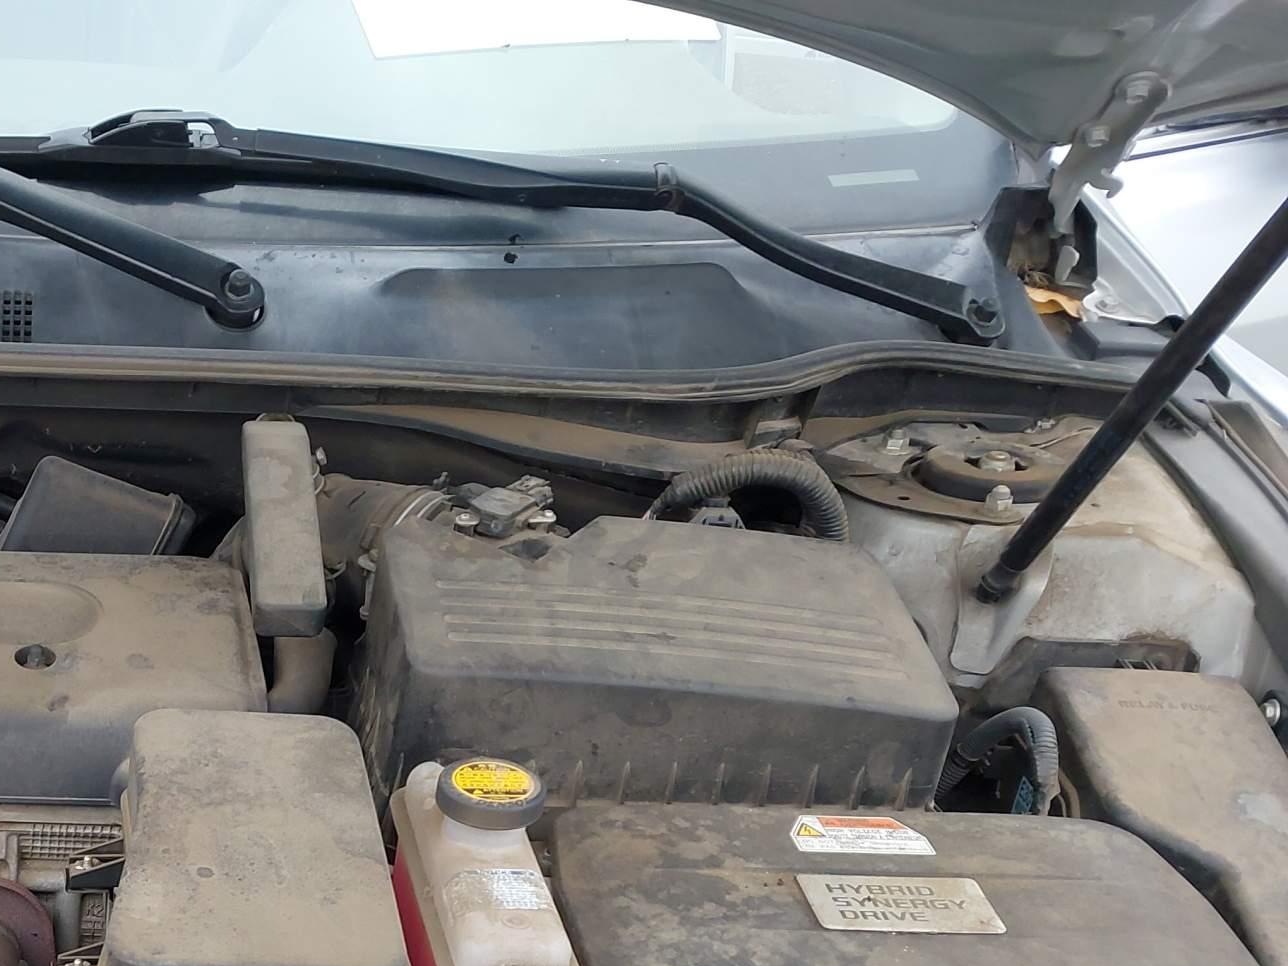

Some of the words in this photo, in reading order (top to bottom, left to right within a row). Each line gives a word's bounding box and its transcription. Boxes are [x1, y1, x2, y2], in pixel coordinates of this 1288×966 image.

[824, 882, 935, 897] HYBRID
[831, 895, 967, 911] SYNERGY
[838, 908, 930, 922] DRIVE
